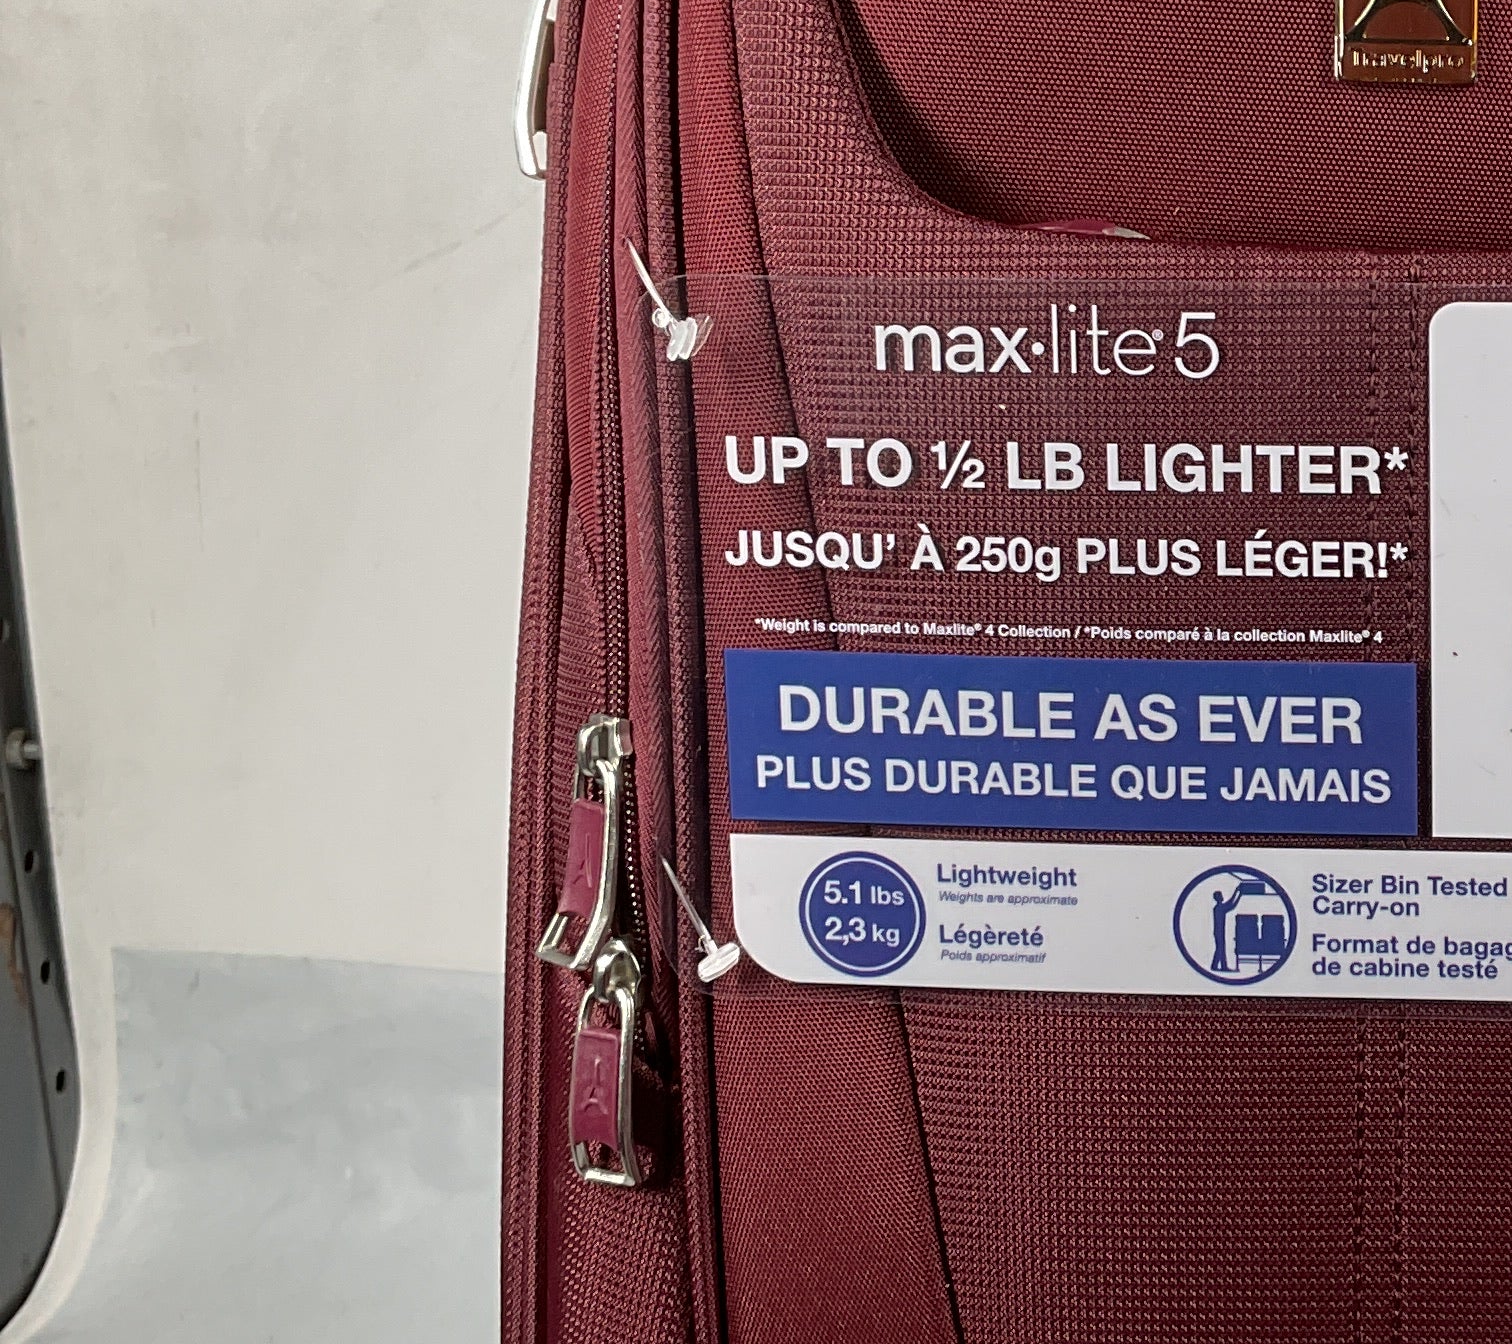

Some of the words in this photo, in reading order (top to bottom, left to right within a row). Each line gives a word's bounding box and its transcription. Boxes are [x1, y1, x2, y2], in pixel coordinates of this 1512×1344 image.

[725, 436, 810, 485] UP
[826, 437, 913, 488] TO
[1006, 441, 1085, 492] LB
[910, 522, 944, 574] À
[955, 535, 1060, 582] 250g
[1077, 536, 1201, 578] PLUS
[813, 618, 826, 633] is
[829, 620, 902, 637] compared
[904, 622, 919, 635] to
[984, 624, 995, 637] 4
[998, 624, 1071, 639] Collection
[1134, 626, 1200, 643] comparé
[1203, 626, 1214, 641] à
[1216, 627, 1230, 642] la
[1233, 628, 1305, 643] collection
[1372, 630, 1384, 644] 4
[779, 684, 1075, 740] DURABLE
[1093, 692, 1179, 742] AS
[1199, 694, 1363, 745] EVER
[756, 754, 871, 792] PLUS
[884, 758, 1097, 800] DURABLE
[1110, 764, 1207, 803] QUE
[1219, 766, 1392, 804] JAMAIS
[937, 863, 1078, 891] Lightweight
[1312, 873, 1374, 895] Sizer
[1381, 874, 1420, 896] Bin
[1427, 875, 1509, 898] Tested
[823, 879, 862, 904] 5.1
[870, 884, 905, 907] lbs
[938, 890, 984, 904] Weights
[986, 894, 1005, 904] are
[1312, 895, 1421, 921] Carry-on
[824, 916, 867, 946] 2,3
[871, 923, 901, 947] kg
[939, 922, 1044, 949] Légèreté
[1312, 933, 1399, 955] Format
[1405, 936, 1436, 956] de
[1311, 956, 1342, 977] de
[1349, 957, 1431, 979] cabine
[1437, 958, 1499, 980] testé
